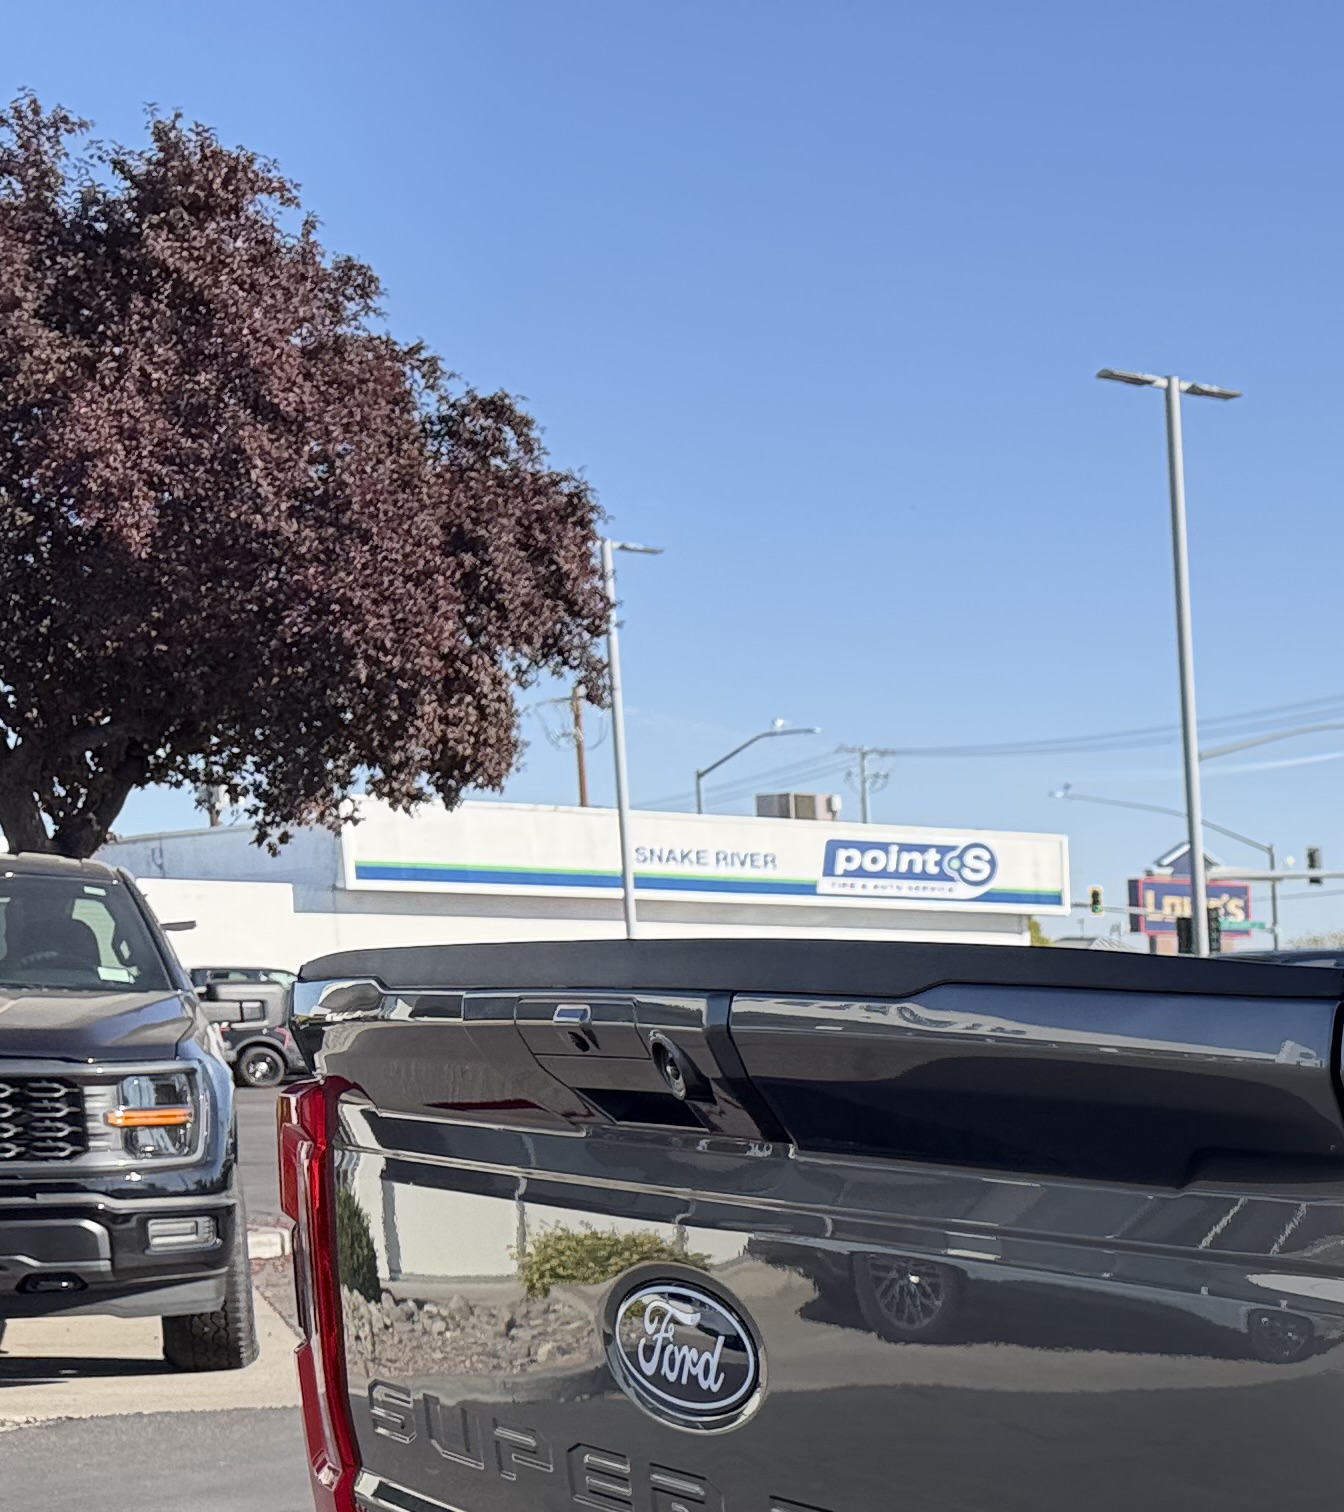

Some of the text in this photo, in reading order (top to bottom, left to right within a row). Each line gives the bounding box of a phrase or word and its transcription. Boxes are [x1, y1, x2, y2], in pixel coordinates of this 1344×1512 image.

[634, 846, 777, 871] SNAKE RIVER
[834, 844, 942, 876] point
[638, 1299, 726, 1393] Ford
